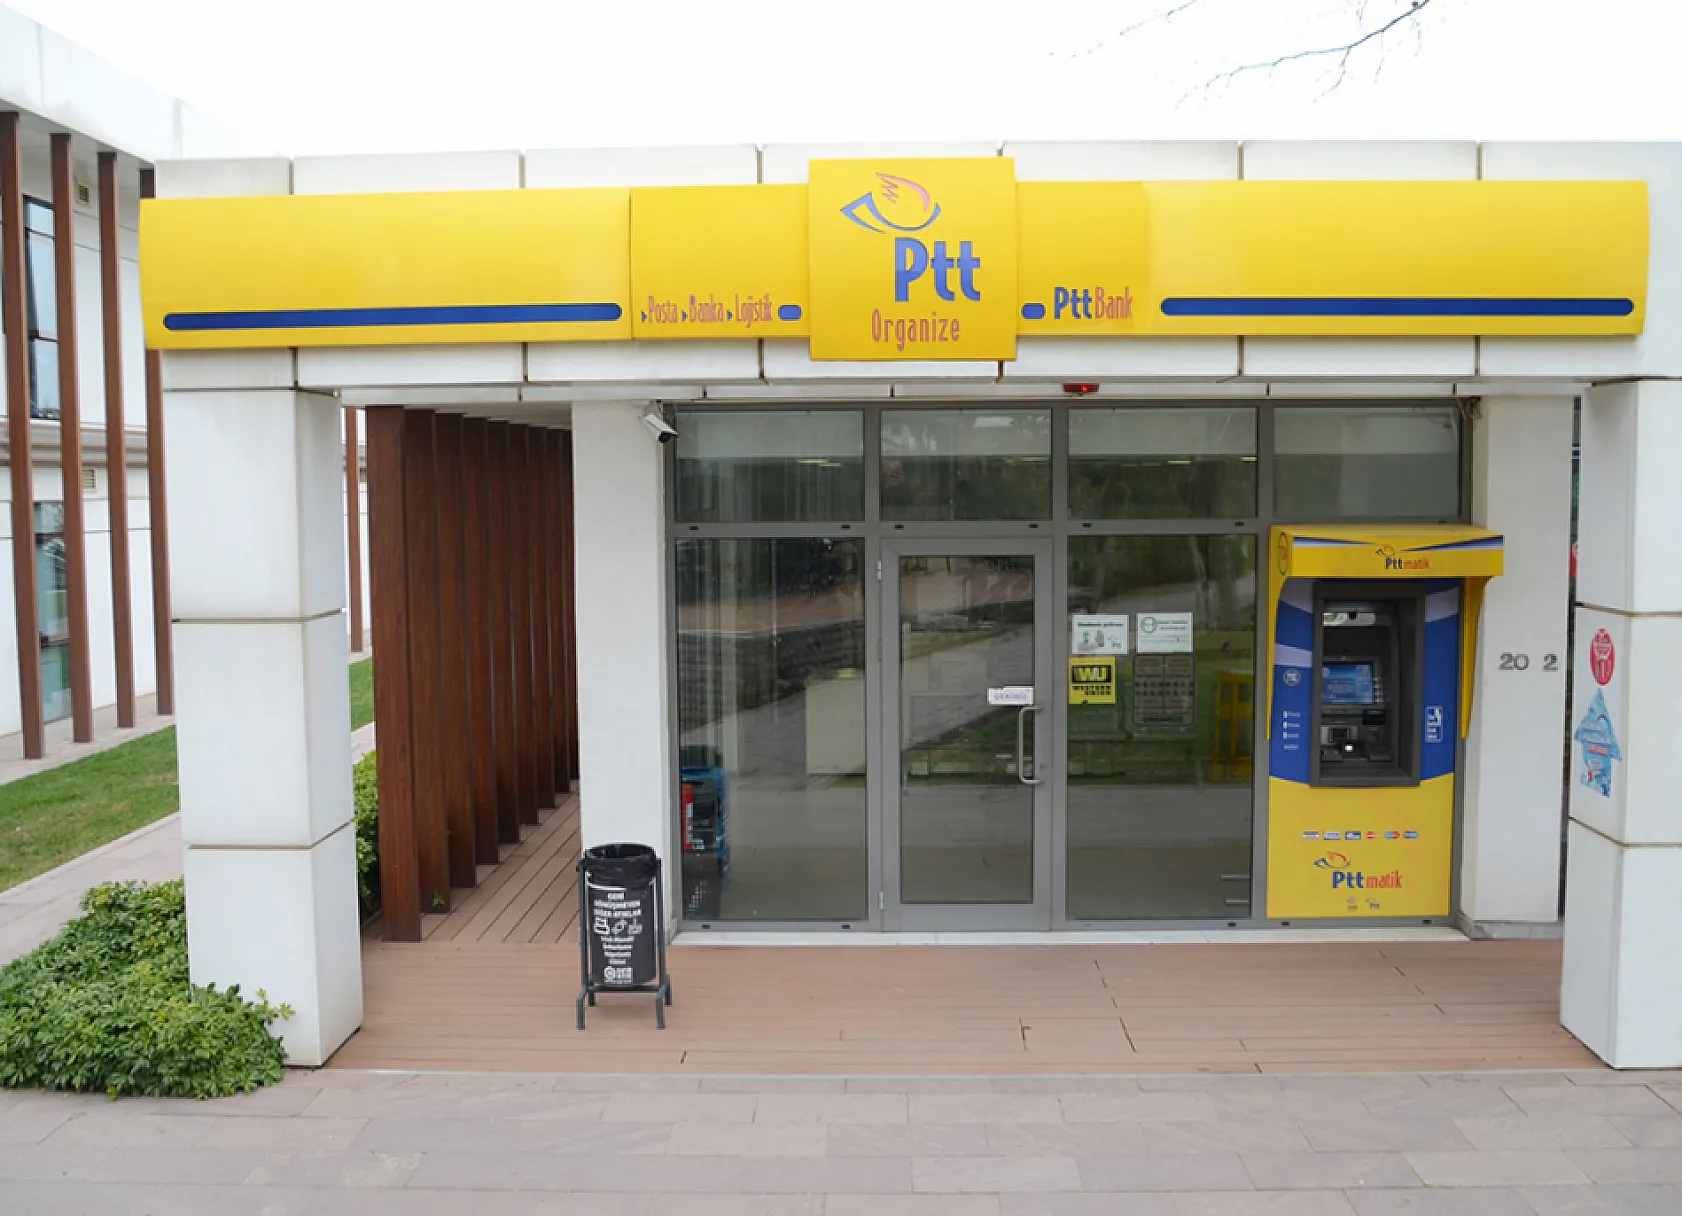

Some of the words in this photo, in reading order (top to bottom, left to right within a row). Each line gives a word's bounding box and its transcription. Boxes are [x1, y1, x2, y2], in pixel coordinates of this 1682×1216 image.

[894, 237, 981, 302] Ptt
[648, 295, 678, 323] Posta
[689, 294, 724, 323] Banka
[735, 293, 773, 328] Lojistik
[872, 308, 960, 351] Organize
[1498, 652, 1530, 671] 20
[1542, 653, 1559, 672] 2
